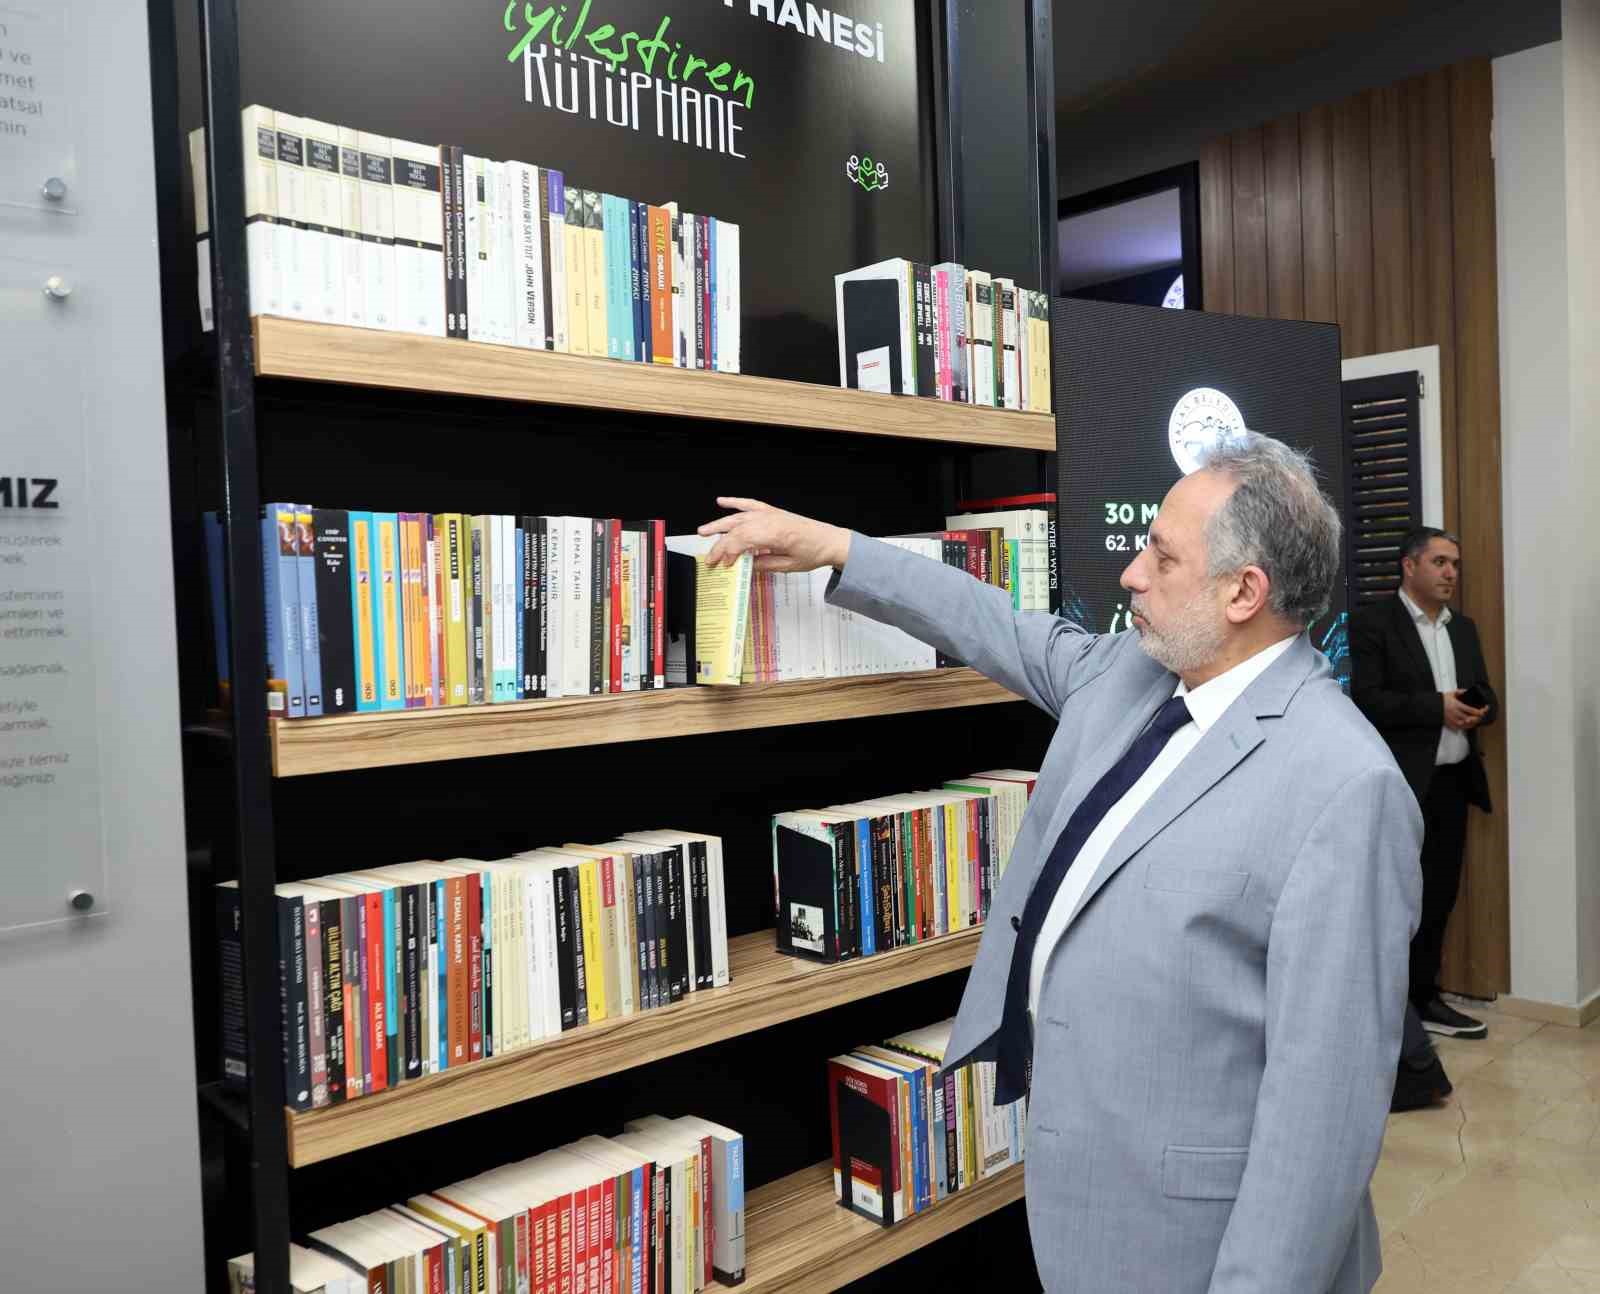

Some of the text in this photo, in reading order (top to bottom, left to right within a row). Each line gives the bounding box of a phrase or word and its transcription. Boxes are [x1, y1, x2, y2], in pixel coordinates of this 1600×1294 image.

[523, 43, 747, 158] KÜTÜPHANE
[525, 263, 534, 287] JOHN
[955, 293, 966, 336] BROWN
[1105, 503, 1134, 524] 30
[1105, 535, 1130, 551] 62.
[573, 530, 581, 600] KEMAL TAHİR
[453, 896, 462, 924] KEMAL
[327, 926, 341, 961] BİLİMİN
[454, 933, 463, 964] KARPAT
[328, 962, 342, 988] ALTIN
[328, 990, 343, 1012] ÇAĞI
[934, 1087, 944, 1122] Dönüş
